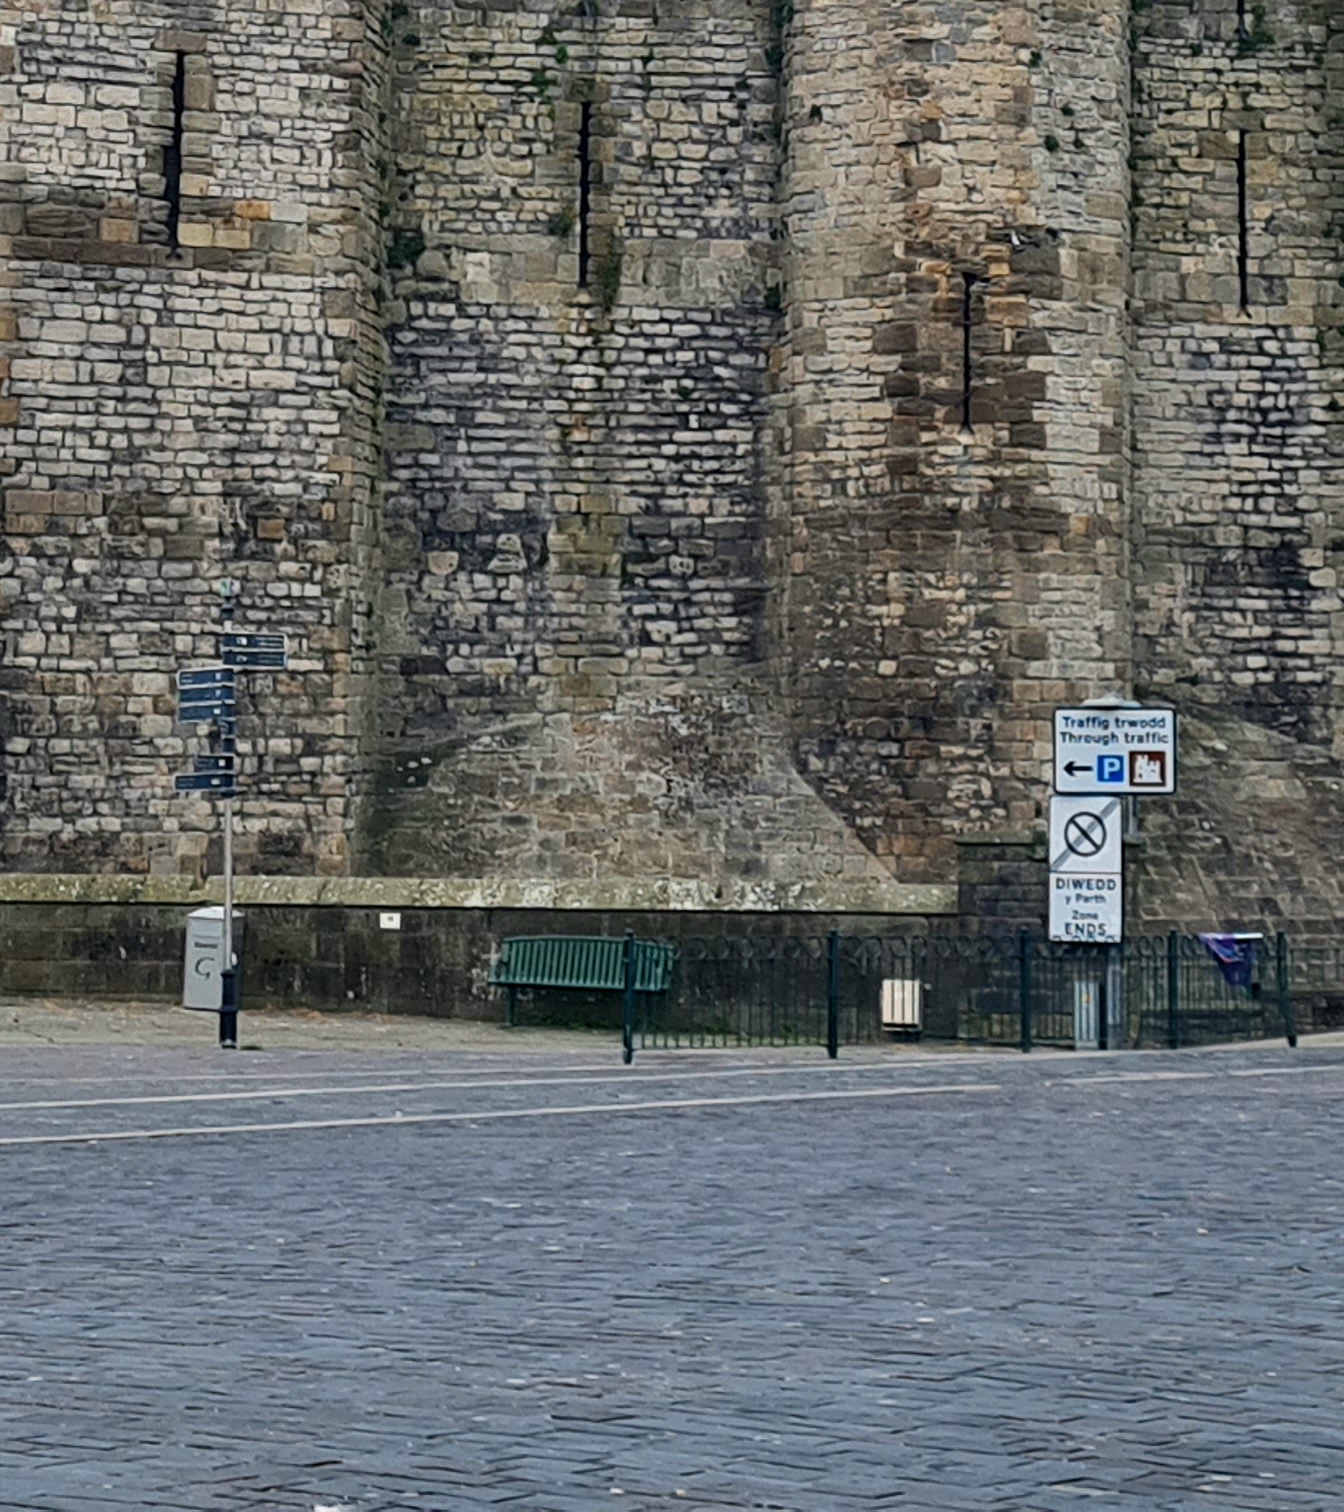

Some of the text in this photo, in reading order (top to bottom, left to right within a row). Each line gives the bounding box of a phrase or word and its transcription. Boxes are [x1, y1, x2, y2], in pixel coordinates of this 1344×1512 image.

[1062, 716, 1166, 730] Traffig trwodd
[1060, 731, 1169, 746] Through traffic
[1103, 757, 1122, 780] P
[1056, 877, 1117, 891] DIWEDD
[1071, 909, 1099, 921] Zone
[1064, 921, 1107, 937] ENDS
